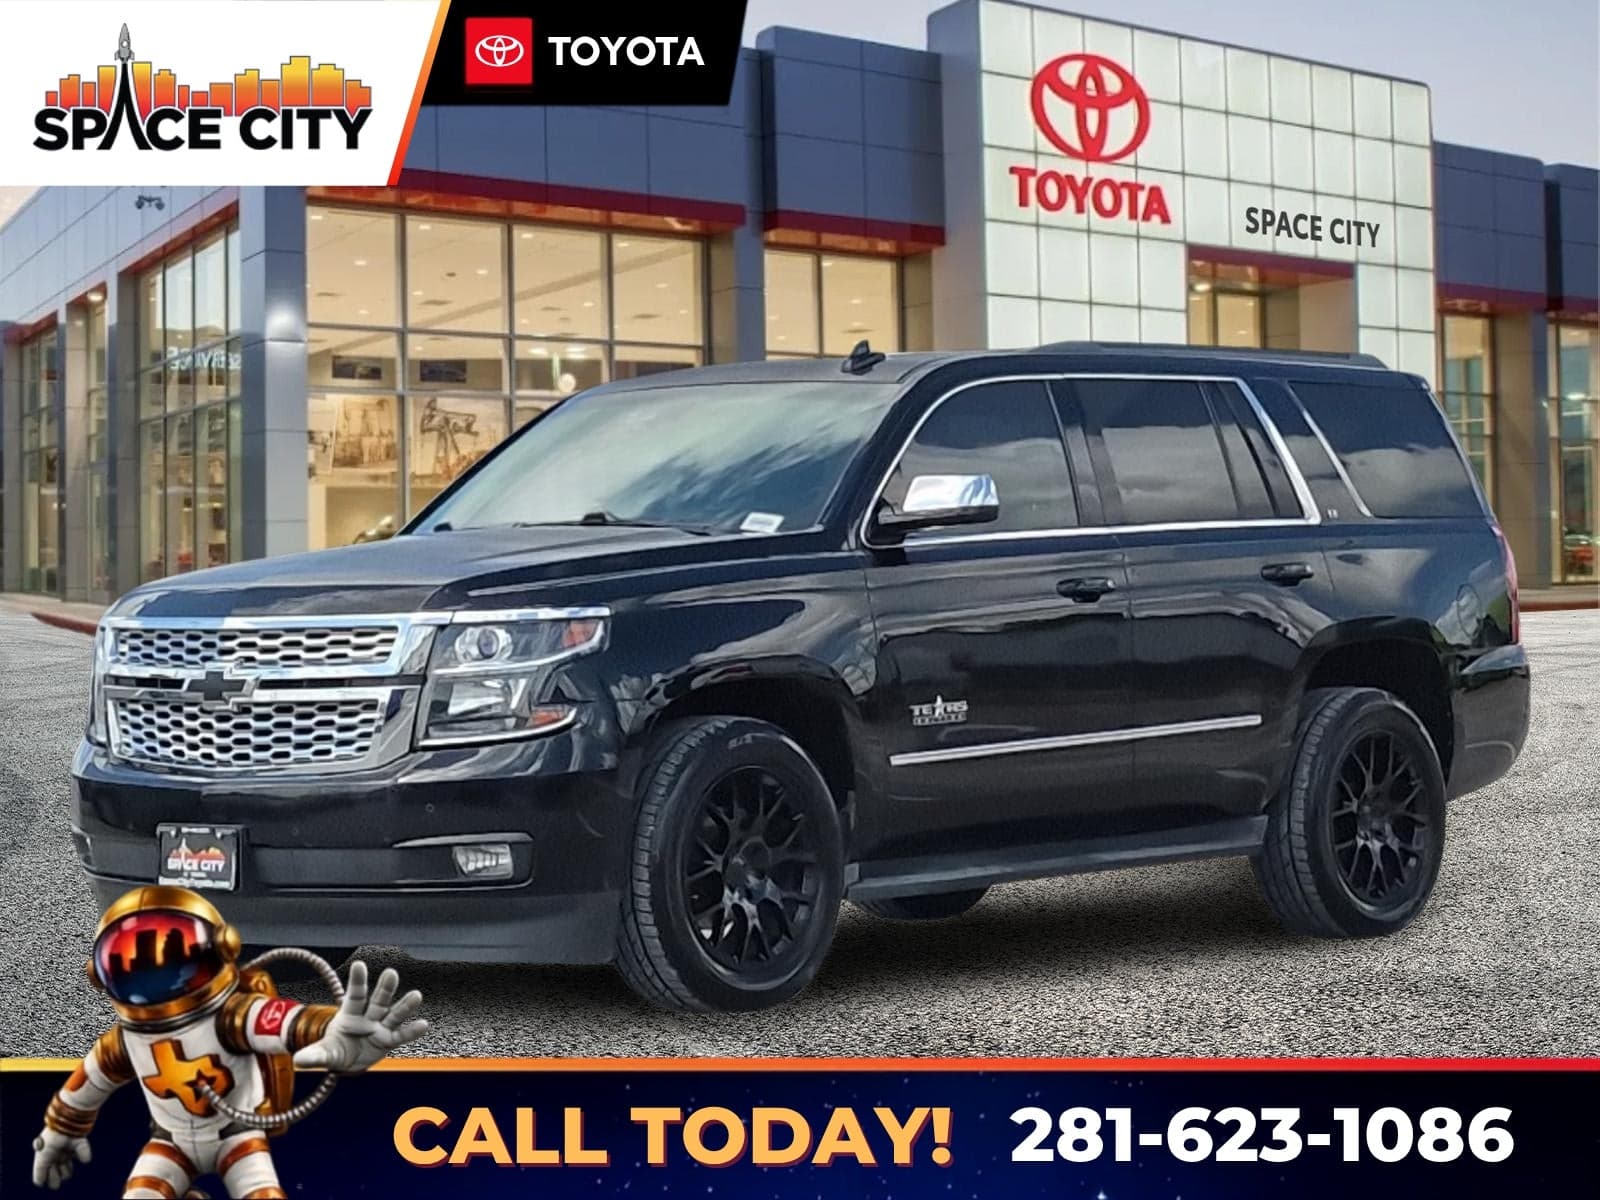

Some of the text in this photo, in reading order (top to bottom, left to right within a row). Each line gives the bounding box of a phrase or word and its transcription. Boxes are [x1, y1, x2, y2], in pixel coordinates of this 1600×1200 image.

[1008, 166, 1171, 224] TOYOTA
[1245, 206, 1381, 248] SPACE CITY
[200, 859, 225, 873] CITY
